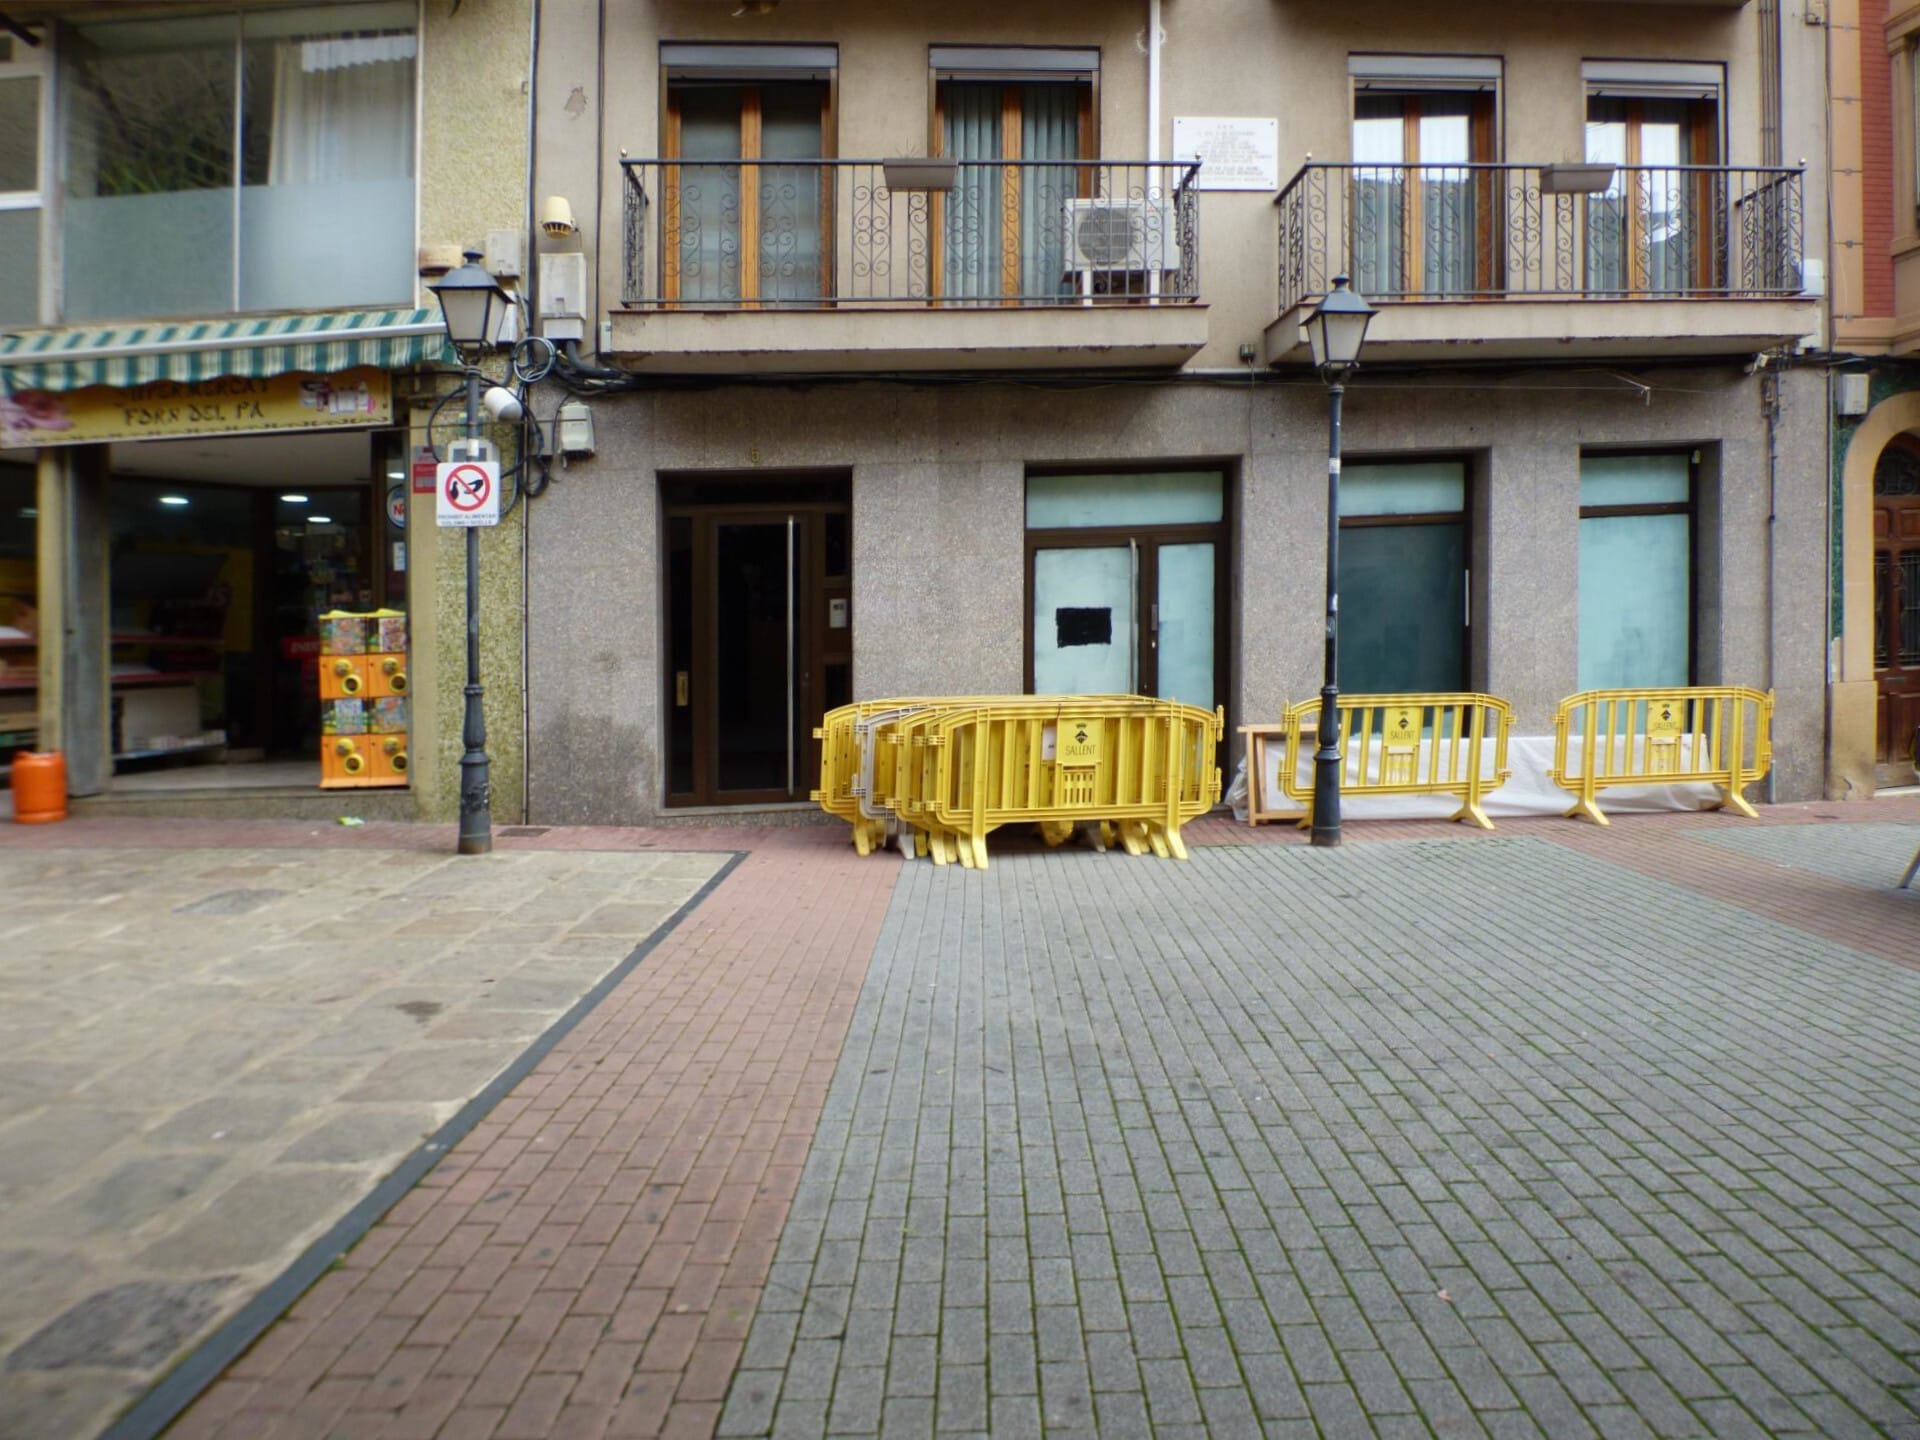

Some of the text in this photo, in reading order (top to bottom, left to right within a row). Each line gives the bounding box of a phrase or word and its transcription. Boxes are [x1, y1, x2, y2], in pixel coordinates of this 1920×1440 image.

[188, 402, 226, 422] DEL
[1390, 730, 1415, 740] SALLENT
[1065, 744, 1096, 756] SALLENT
